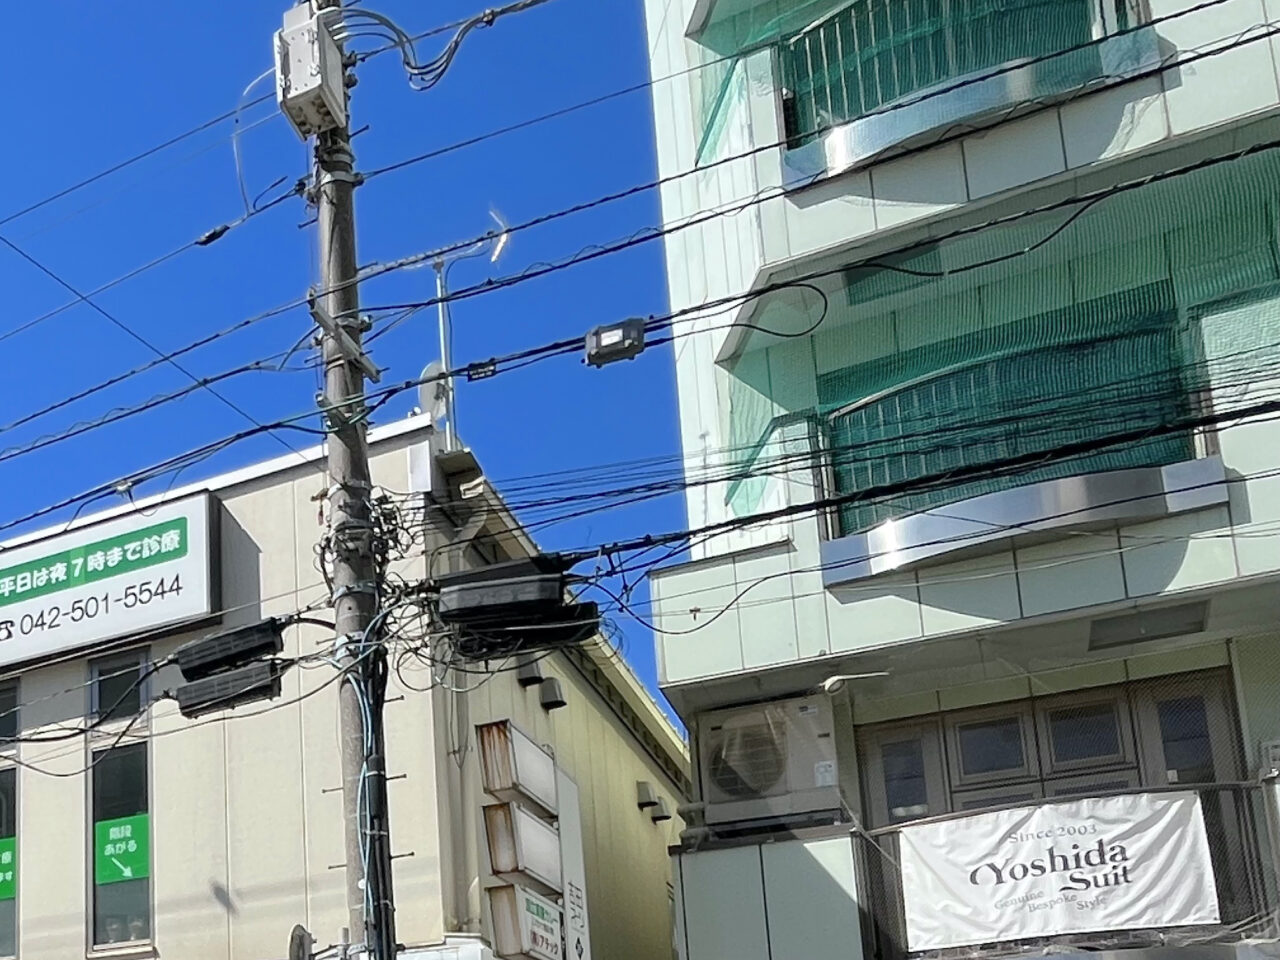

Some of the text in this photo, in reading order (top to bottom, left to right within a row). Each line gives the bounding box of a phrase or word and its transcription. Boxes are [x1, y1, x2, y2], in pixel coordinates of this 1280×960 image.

[20, 573, 183, 635] 042-501-5544
[1009, 824, 1097, 843] Since 2003
[104, 840, 137, 855] あがる
[970, 838, 1129, 886] Yoshida
[1059, 865, 1133, 892] Suit
[994, 890, 1045, 909] Genuine
[1028, 894, 1078, 912] Bespoke
